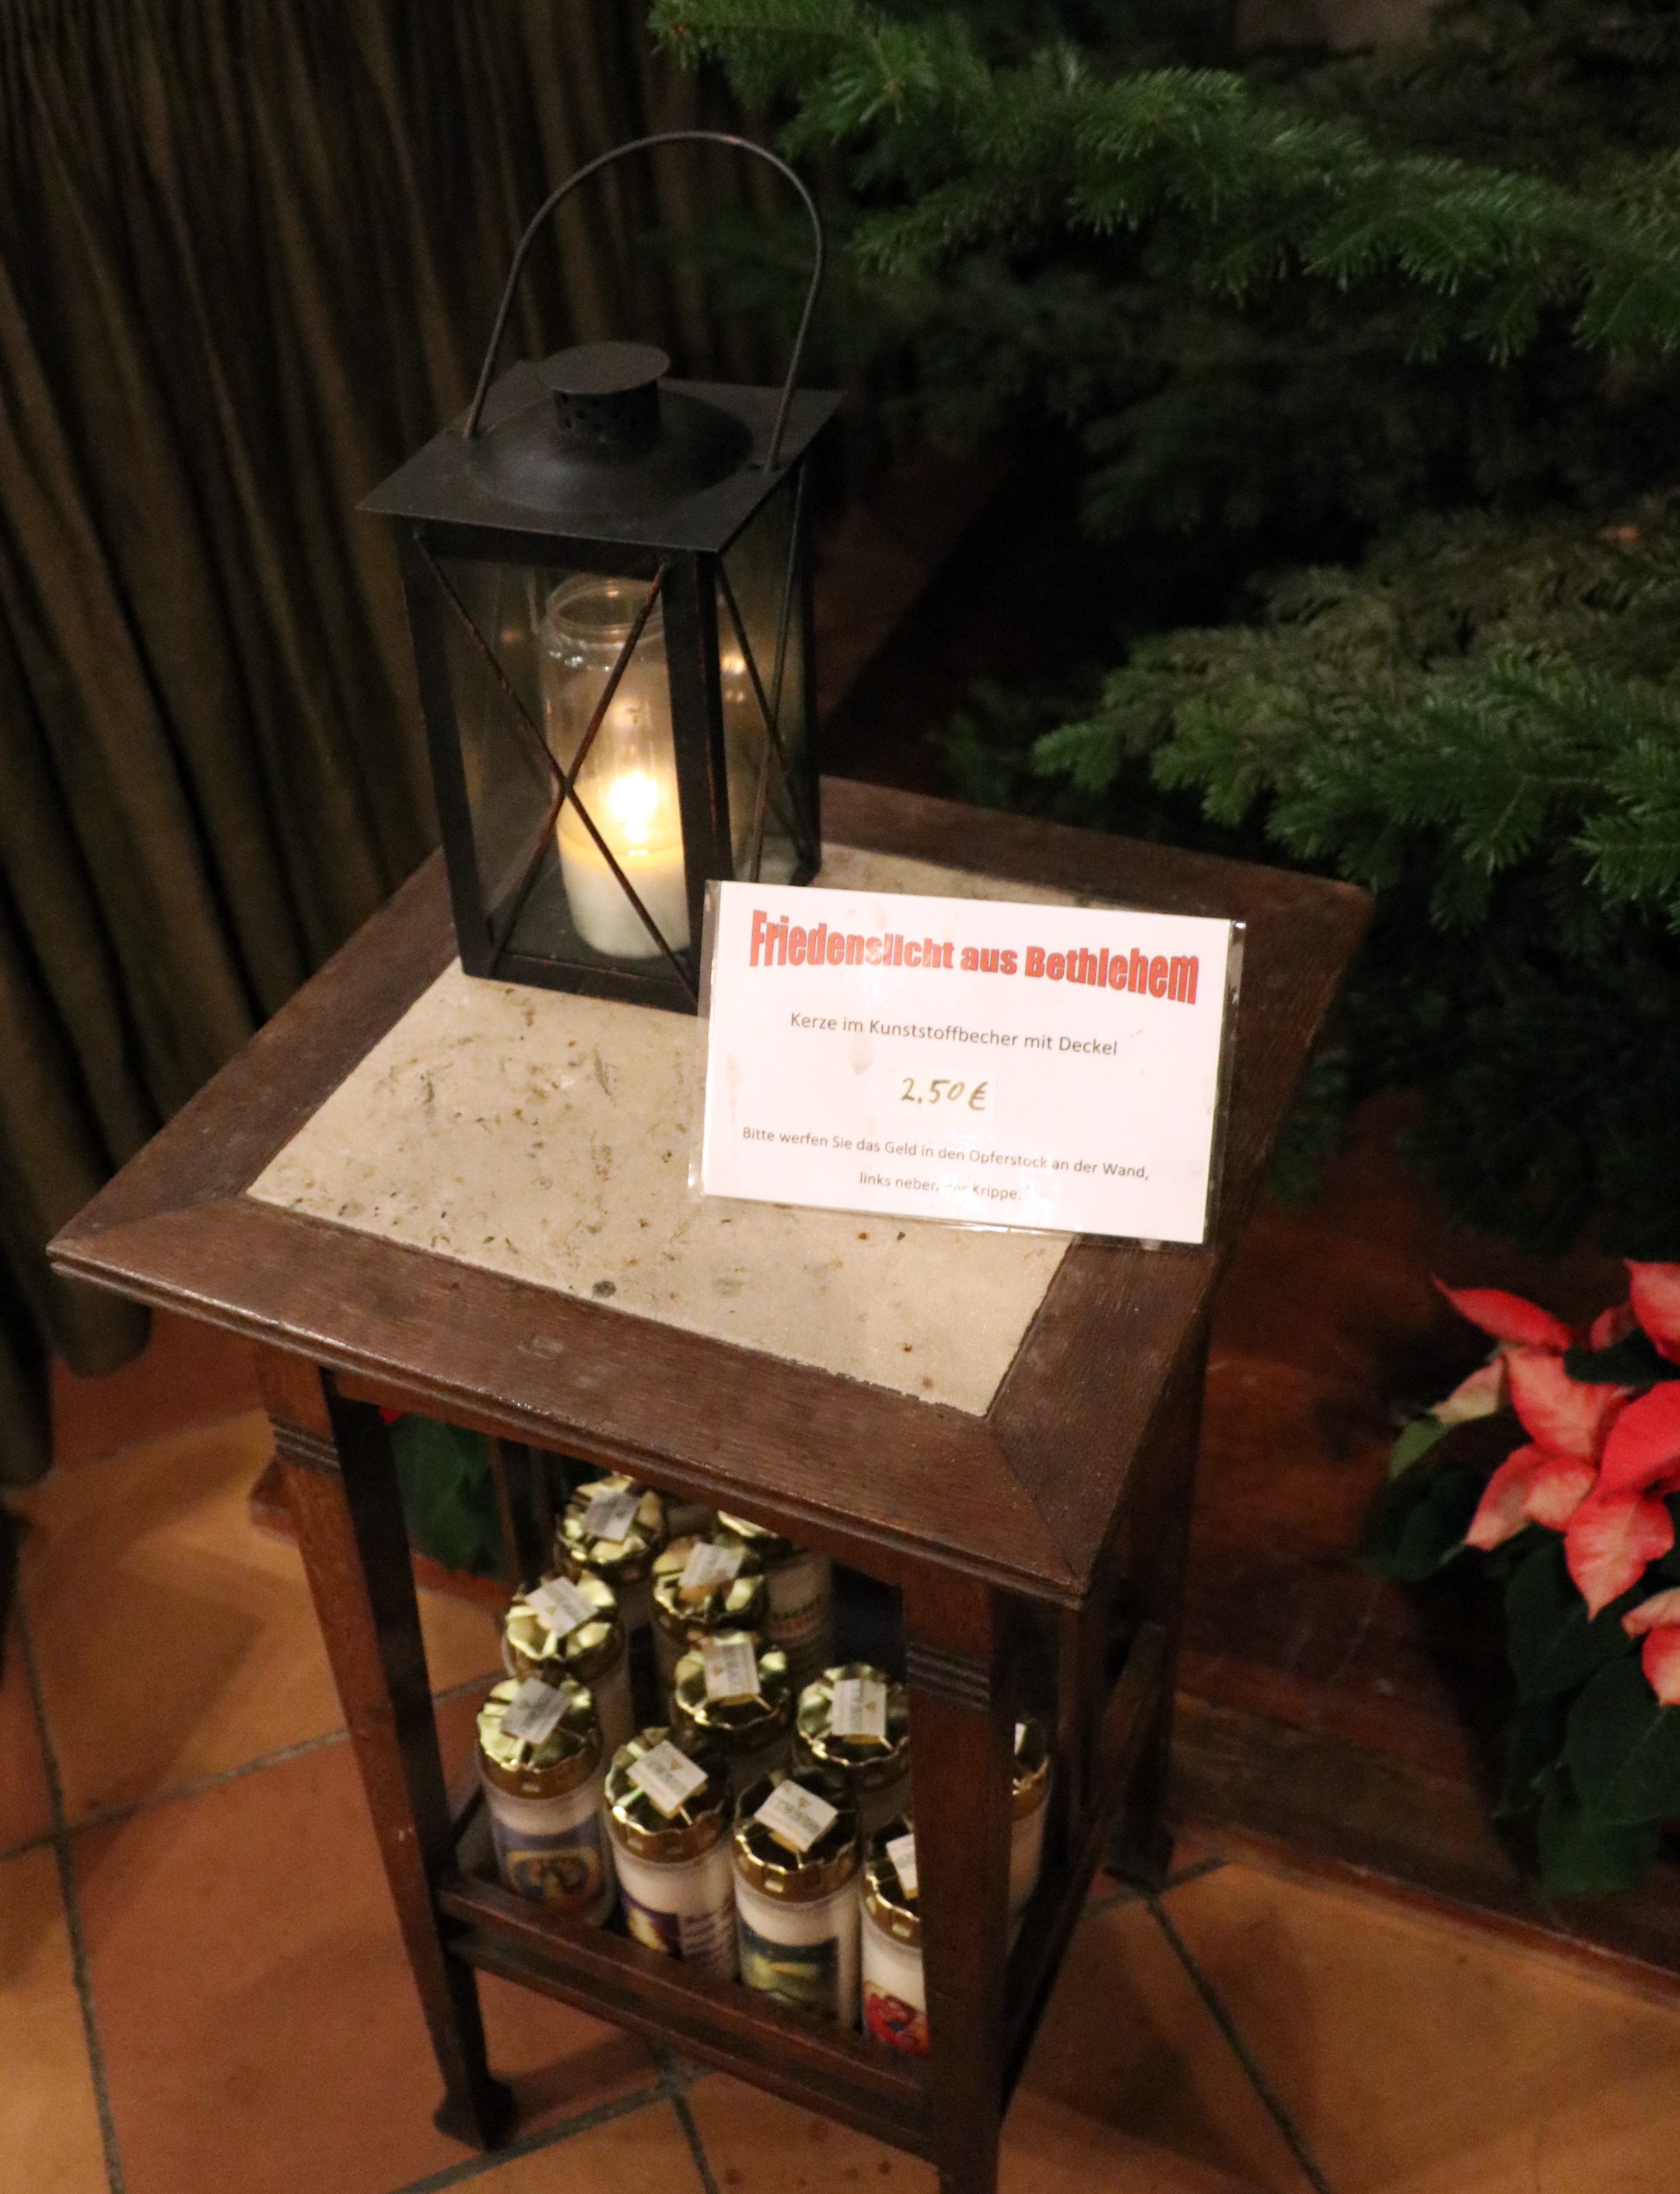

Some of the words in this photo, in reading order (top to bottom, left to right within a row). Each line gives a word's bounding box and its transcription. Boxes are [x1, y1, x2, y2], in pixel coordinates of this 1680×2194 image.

[749, 909, 954, 969] Friedenslicht
[960, 946, 1017, 975] aus
[1024, 945, 1200, 1005] Bethlehem
[790, 1012, 838, 1031] Kerze
[842, 1017, 864, 1033] im
[869, 1020, 1019, 1046] Kunststoffbecher
[1024, 1034, 1054, 1051] mit
[1059, 1036, 1118, 1055] Deckel
[743, 1127, 775, 1141] Bitte
[779, 1132, 828, 1147] werfen
[832, 1135, 852, 1149] Sie
[856, 1138, 880, 1153] das
[884, 1141, 917, 1156] Geld
[921, 1144, 934, 1157] in
[938, 1147, 965, 1161] den
[968, 1149, 1048, 1168] Opferstock
[1052, 1159, 1069, 1171] an
[1073, 1159, 1098, 1174] der
[1103, 1162, 1150, 1181] Wand,
[859, 1171, 891, 1188] links
